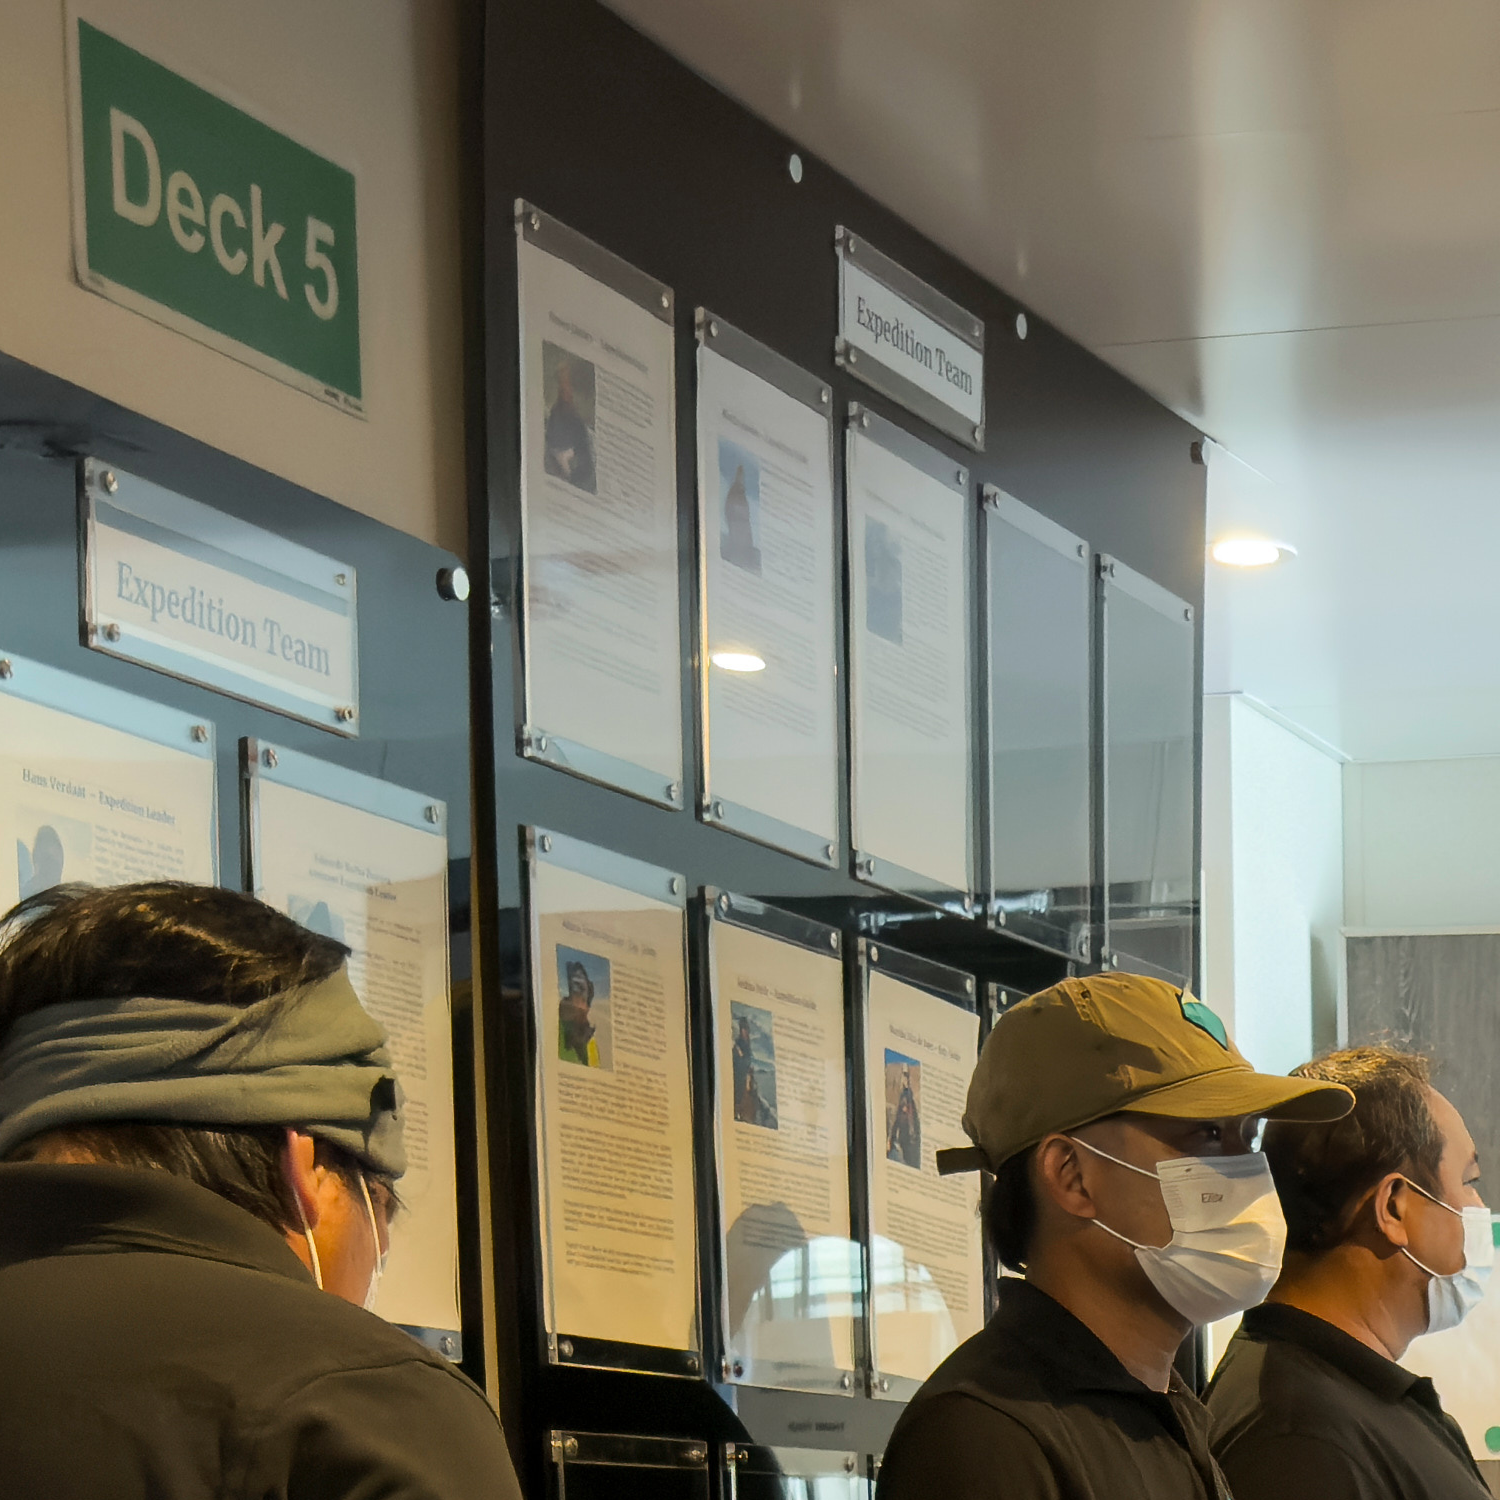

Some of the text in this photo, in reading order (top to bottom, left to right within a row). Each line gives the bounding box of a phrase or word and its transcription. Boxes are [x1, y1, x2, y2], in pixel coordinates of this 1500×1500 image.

[109, 105, 340, 321] Deck 5
[857, 296, 973, 396] Expedition Team
[115, 560, 332, 677] Expedition Team
